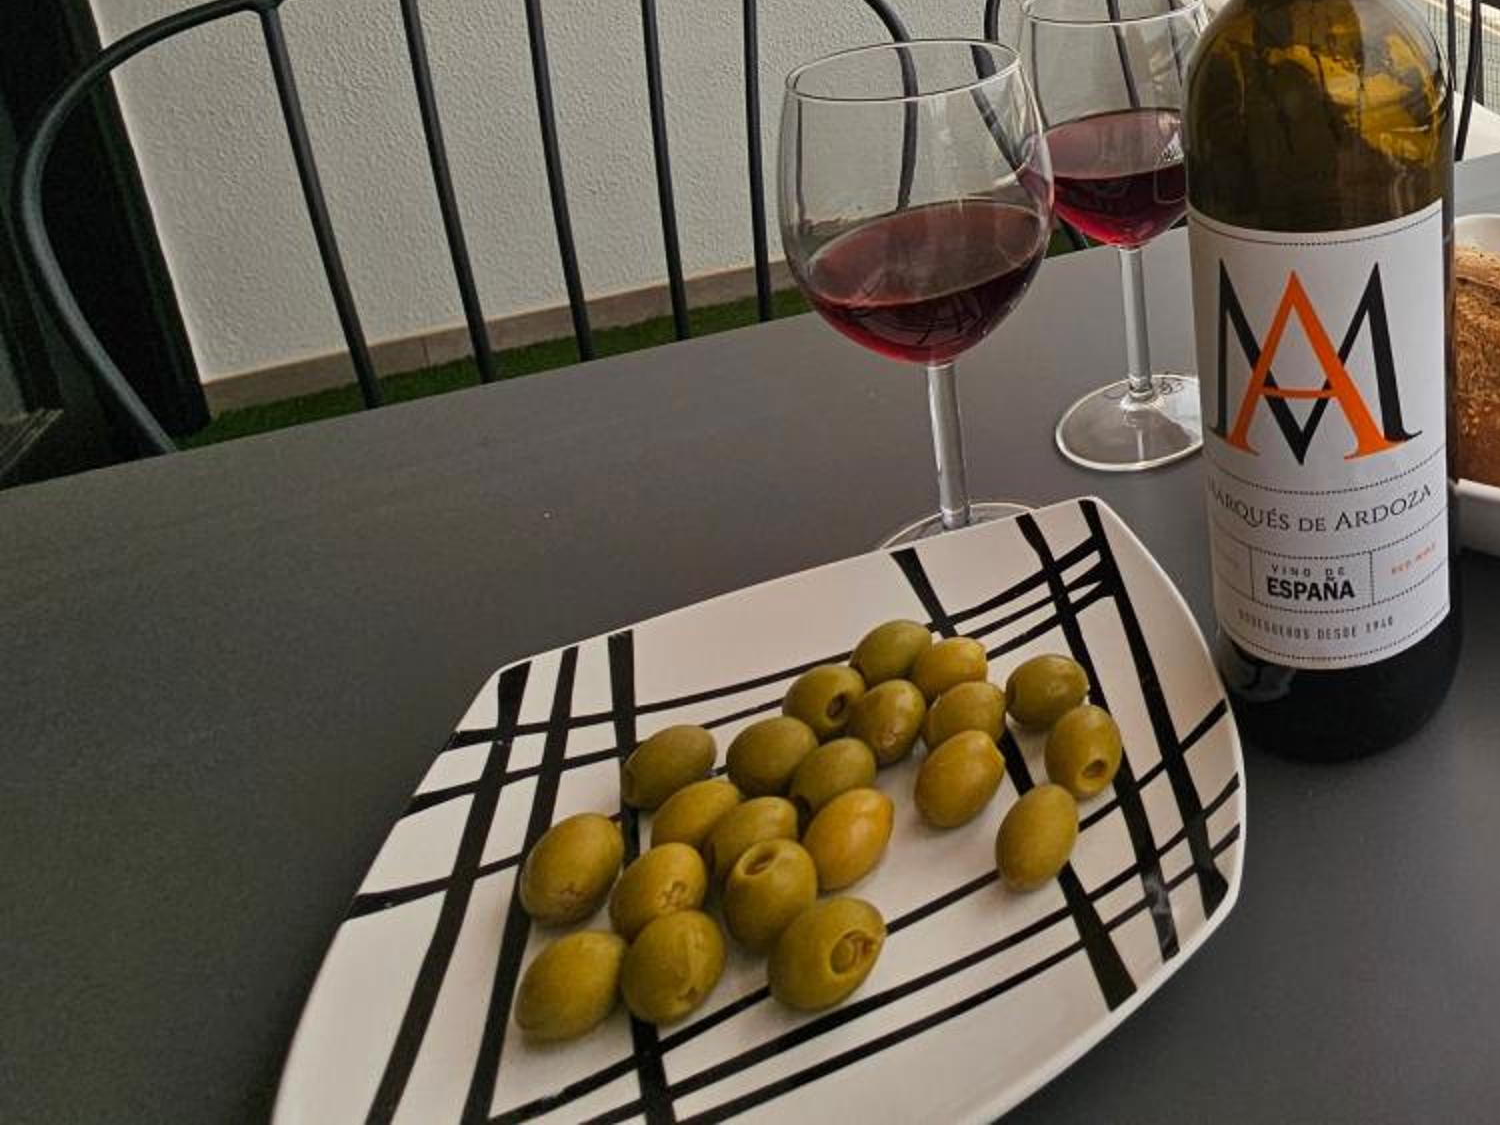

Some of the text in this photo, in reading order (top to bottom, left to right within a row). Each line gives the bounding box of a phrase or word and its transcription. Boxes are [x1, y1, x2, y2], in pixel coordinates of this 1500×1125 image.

[1298, 517, 1326, 532] DE
[1335, 484, 1431, 531] ARDOZA
[1272, 563, 1345, 577] VINO DE
[1267, 575, 1355, 601] ESPAÑA
